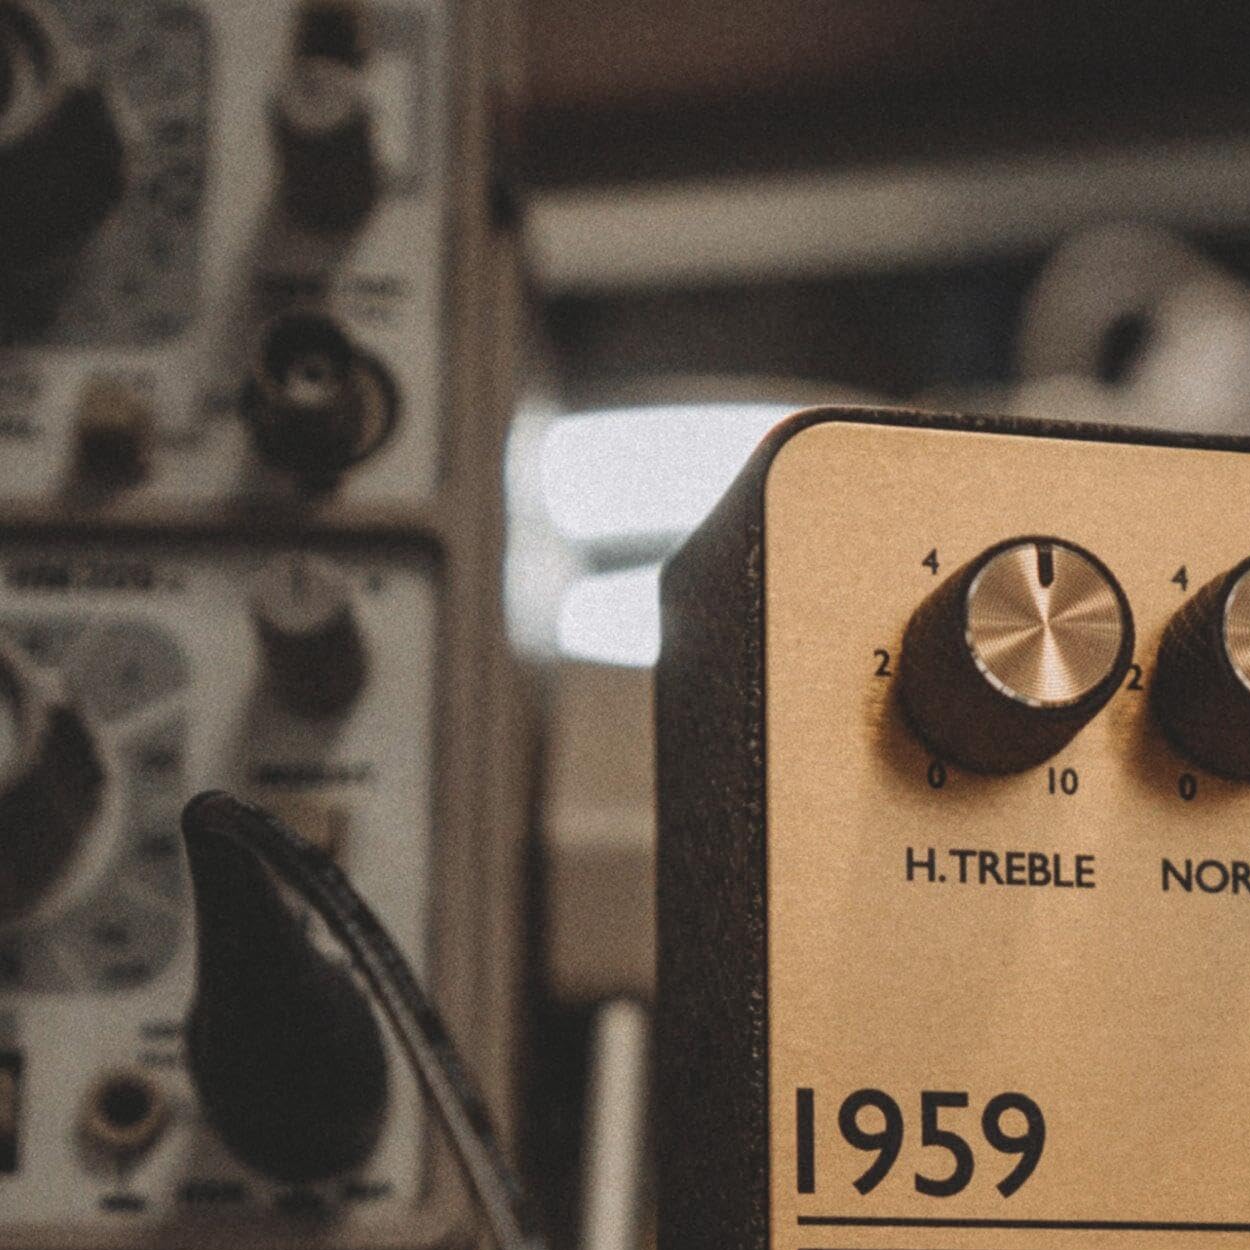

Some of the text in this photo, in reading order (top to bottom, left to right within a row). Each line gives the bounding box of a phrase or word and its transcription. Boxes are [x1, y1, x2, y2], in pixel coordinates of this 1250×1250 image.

[922, 549, 941, 576] 4
[1171, 566, 1189, 592] 4
[873, 649, 893, 678] 2
[926, 760, 947, 789] 0
[1047, 767, 1079, 796] 10
[905, 847, 1096, 889] H.TREBLE
[796, 1086, 1047, 1199] 1959
